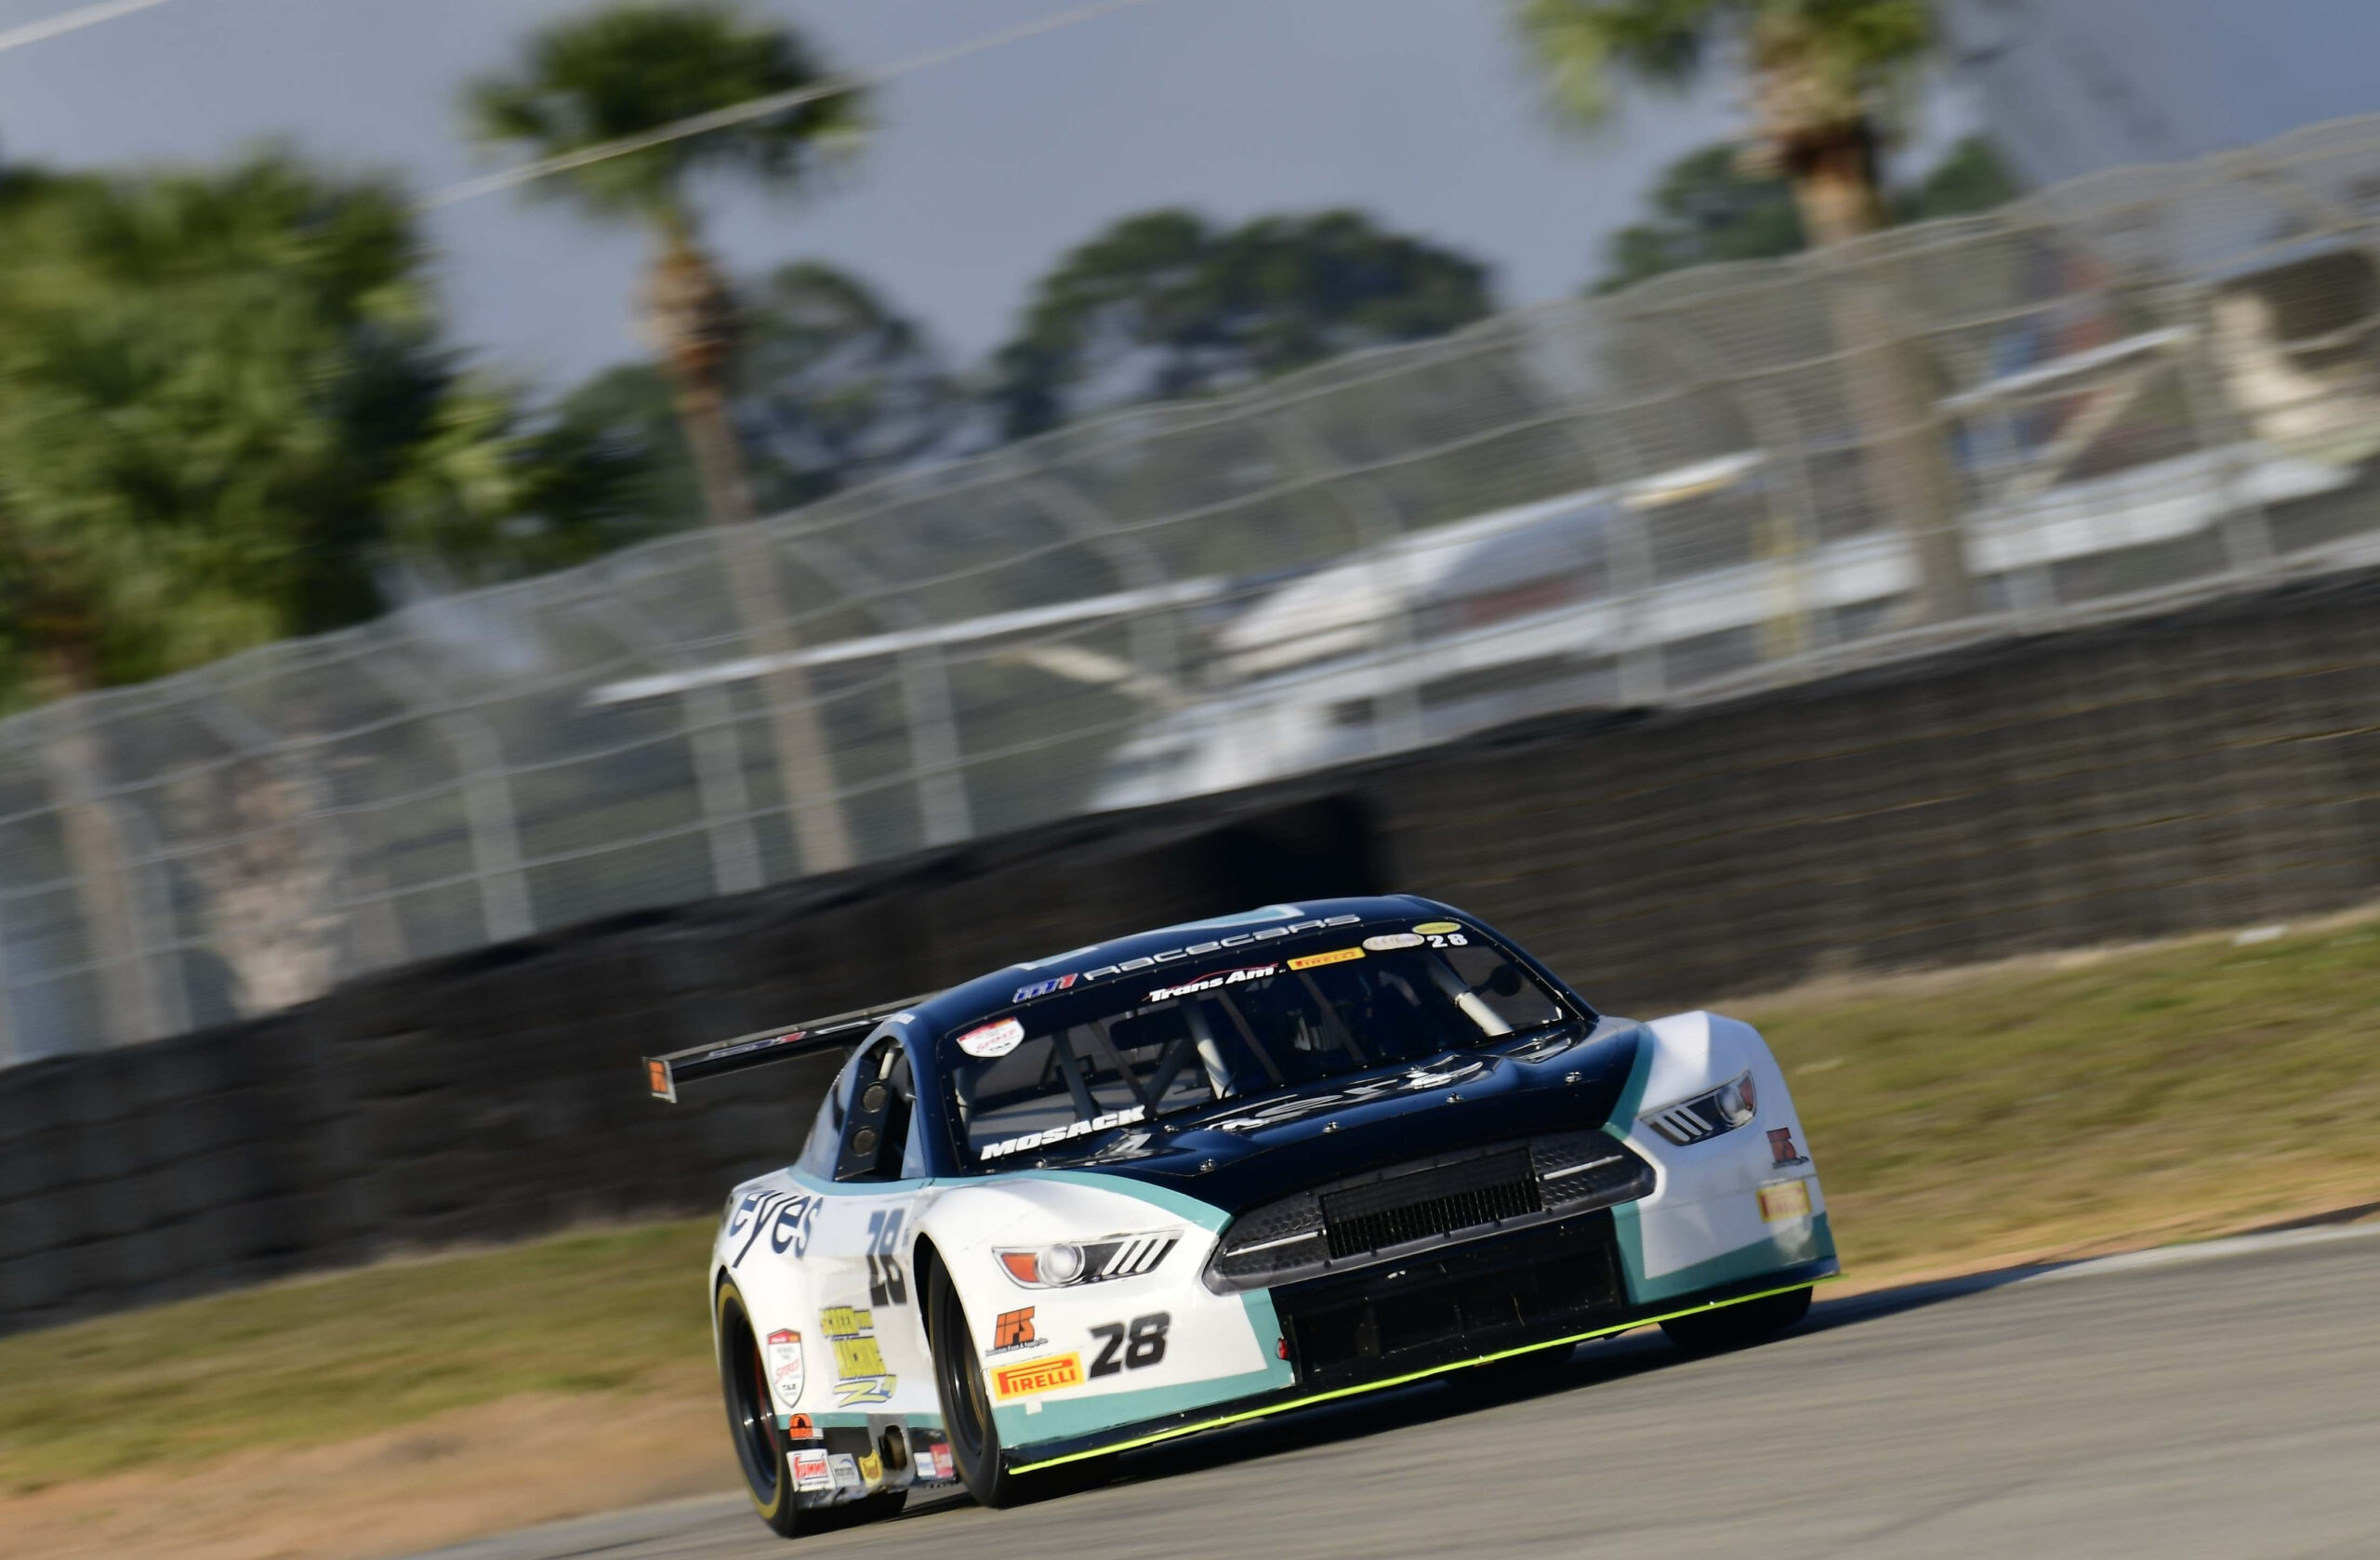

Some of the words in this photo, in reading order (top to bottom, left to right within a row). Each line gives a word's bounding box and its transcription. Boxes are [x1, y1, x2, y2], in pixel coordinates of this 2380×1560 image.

[1426, 933, 1469, 948] 28
[1148, 977, 1224, 1003] Trans
[1225, 966, 1276, 985] Am
[980, 1104, 1146, 1160] MOSACK
[729, 1189, 824, 1269] eyes
[1088, 1310, 1171, 1380] 28
[997, 1357, 1077, 1395] PIRELLI
